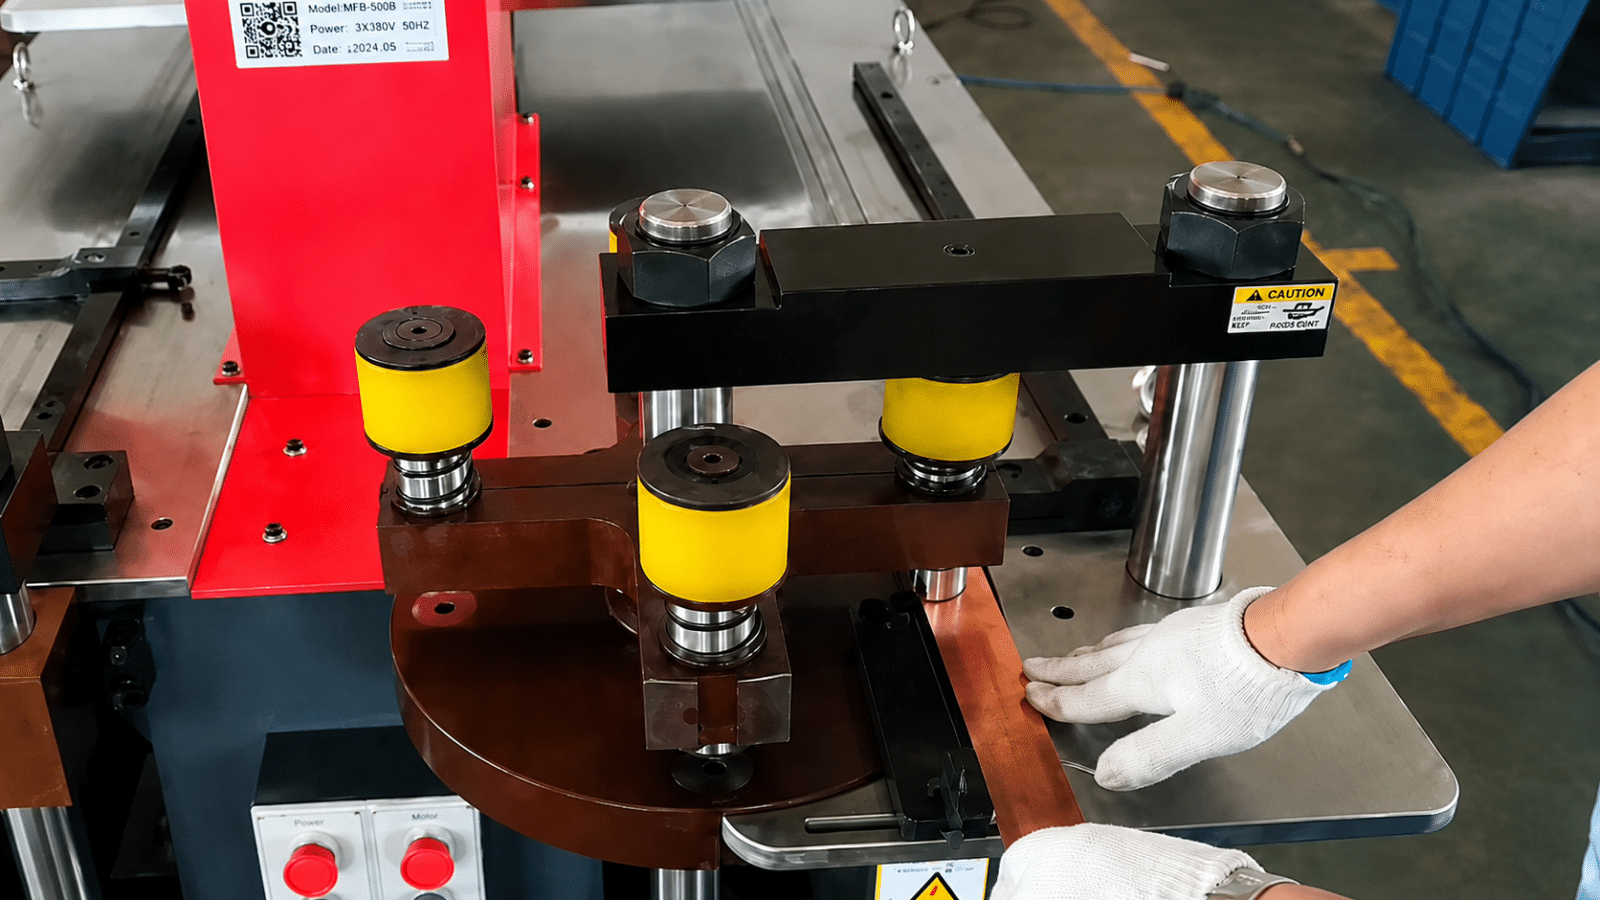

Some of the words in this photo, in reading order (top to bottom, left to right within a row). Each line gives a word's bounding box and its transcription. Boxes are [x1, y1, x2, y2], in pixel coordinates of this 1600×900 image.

[310, 24, 348, 34] Power:
[355, 22, 396, 32] 3X380V
[402, 21, 430, 30] 50HZ
[313, 44, 341, 54] Date:
[1268, 288, 1325, 299] CAUTION
[412, 812, 438, 821] Motor
[294, 819, 324, 827] Power
